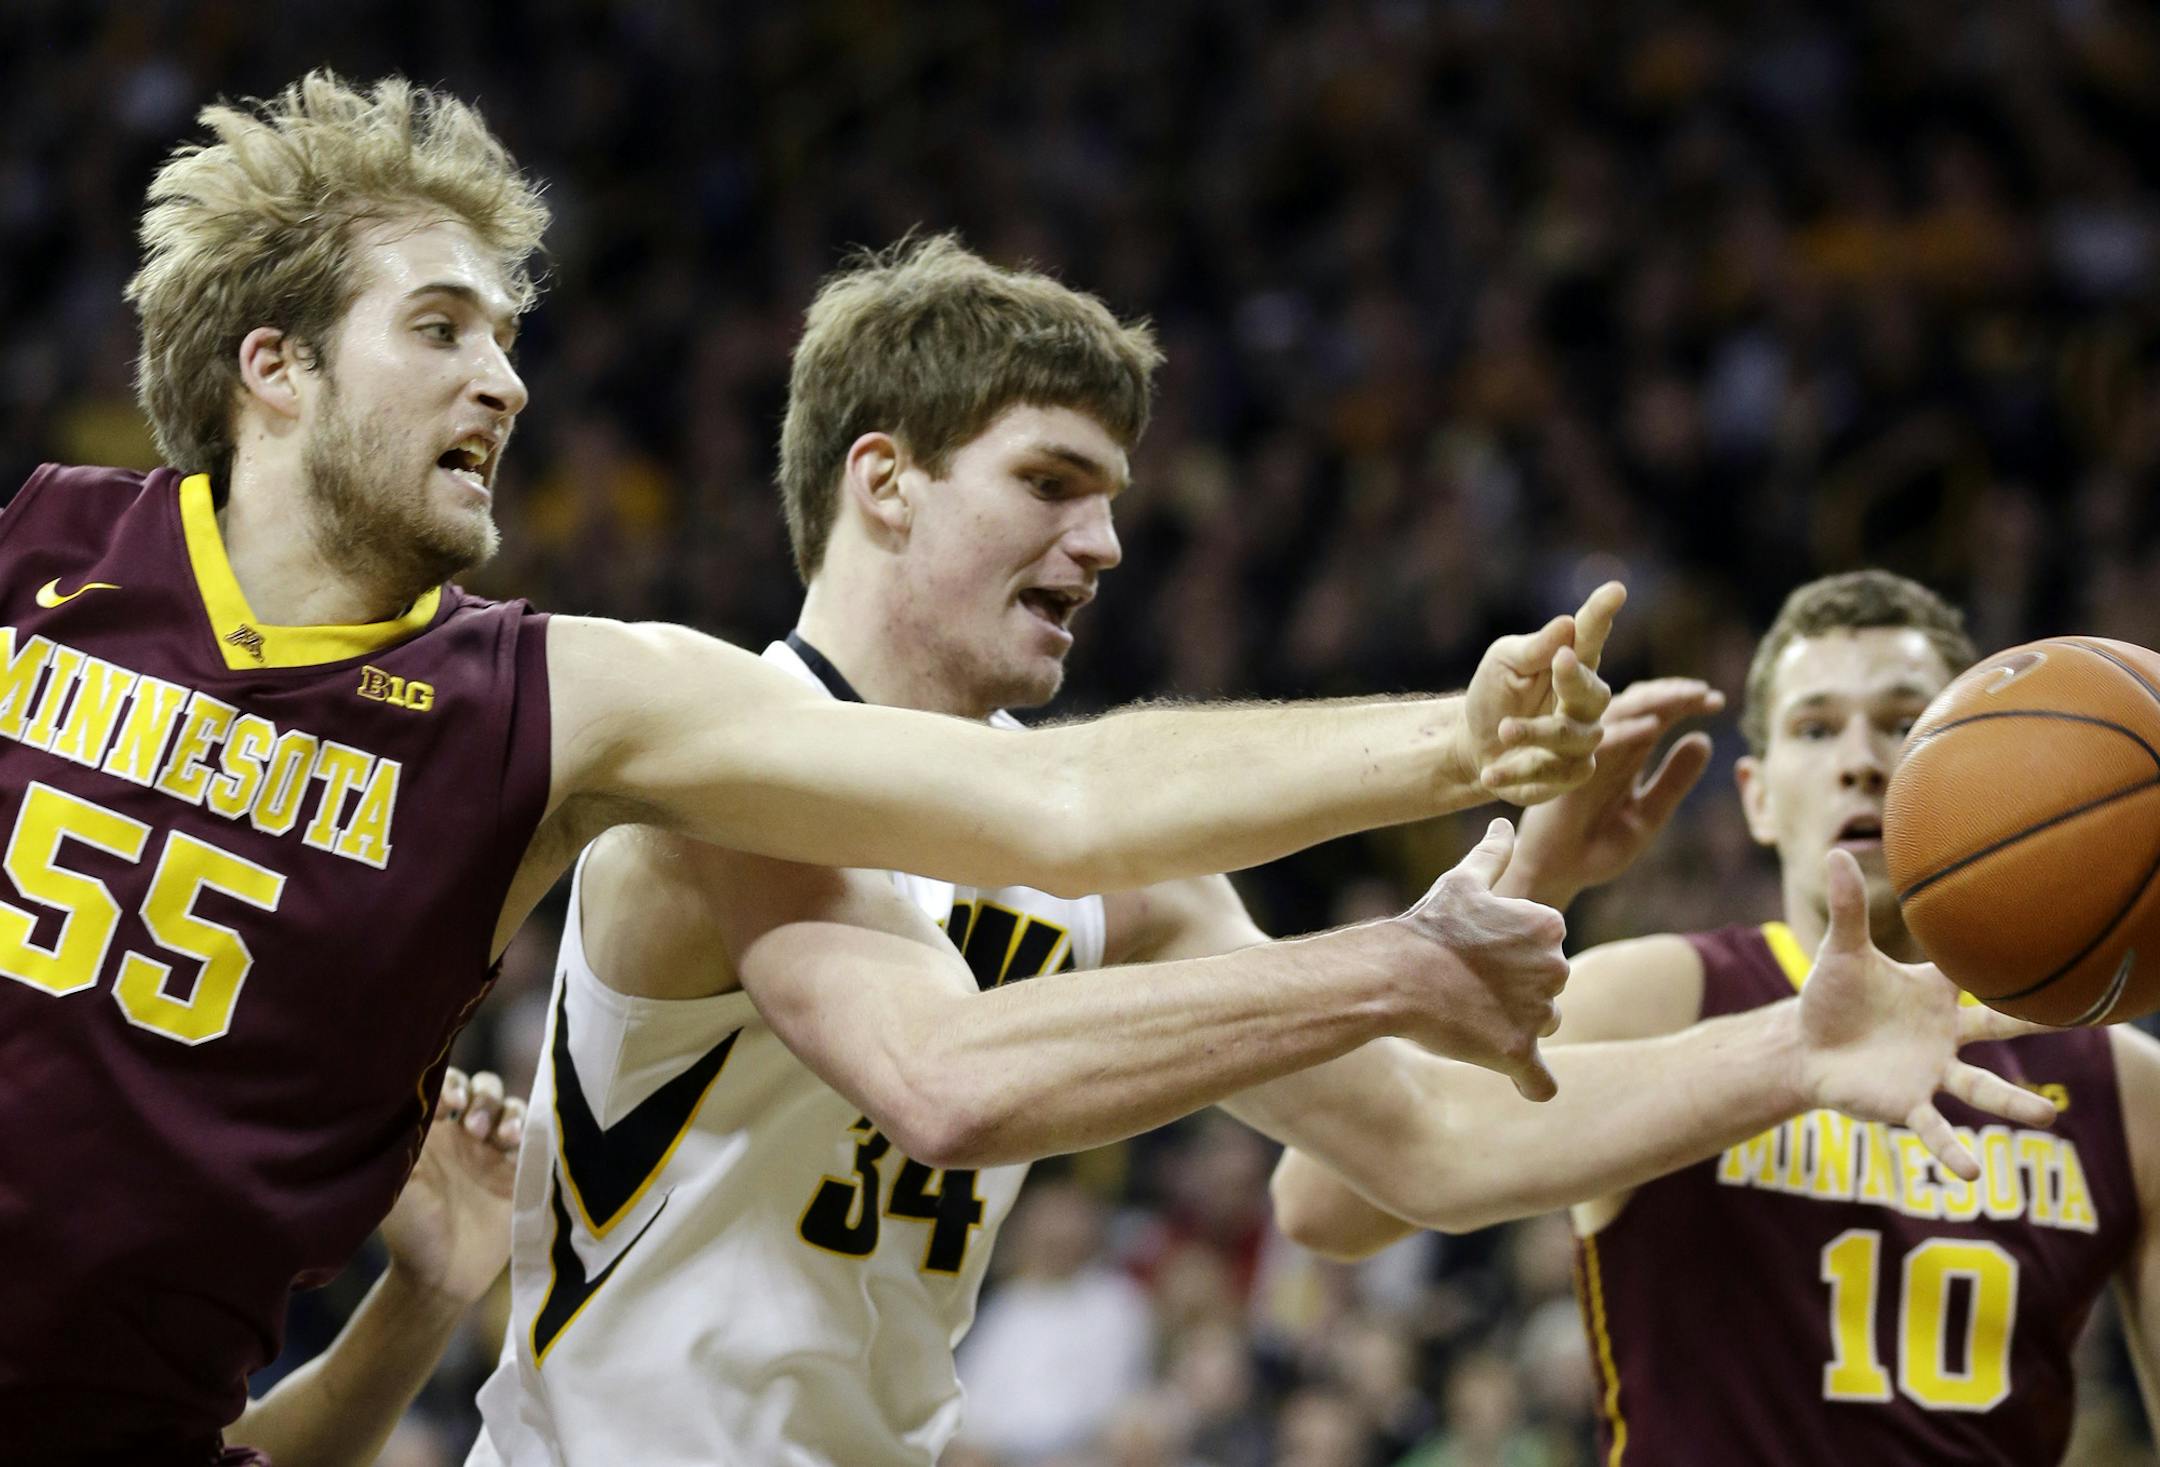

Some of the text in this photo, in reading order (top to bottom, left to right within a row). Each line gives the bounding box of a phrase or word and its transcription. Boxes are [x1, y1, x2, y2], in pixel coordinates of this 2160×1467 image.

[0, 626, 402, 870] MINNESOTA
[0, 781, 287, 1046] 55
[797, 1116, 986, 1277] 34
[1821, 1228, 2019, 1413] 10
